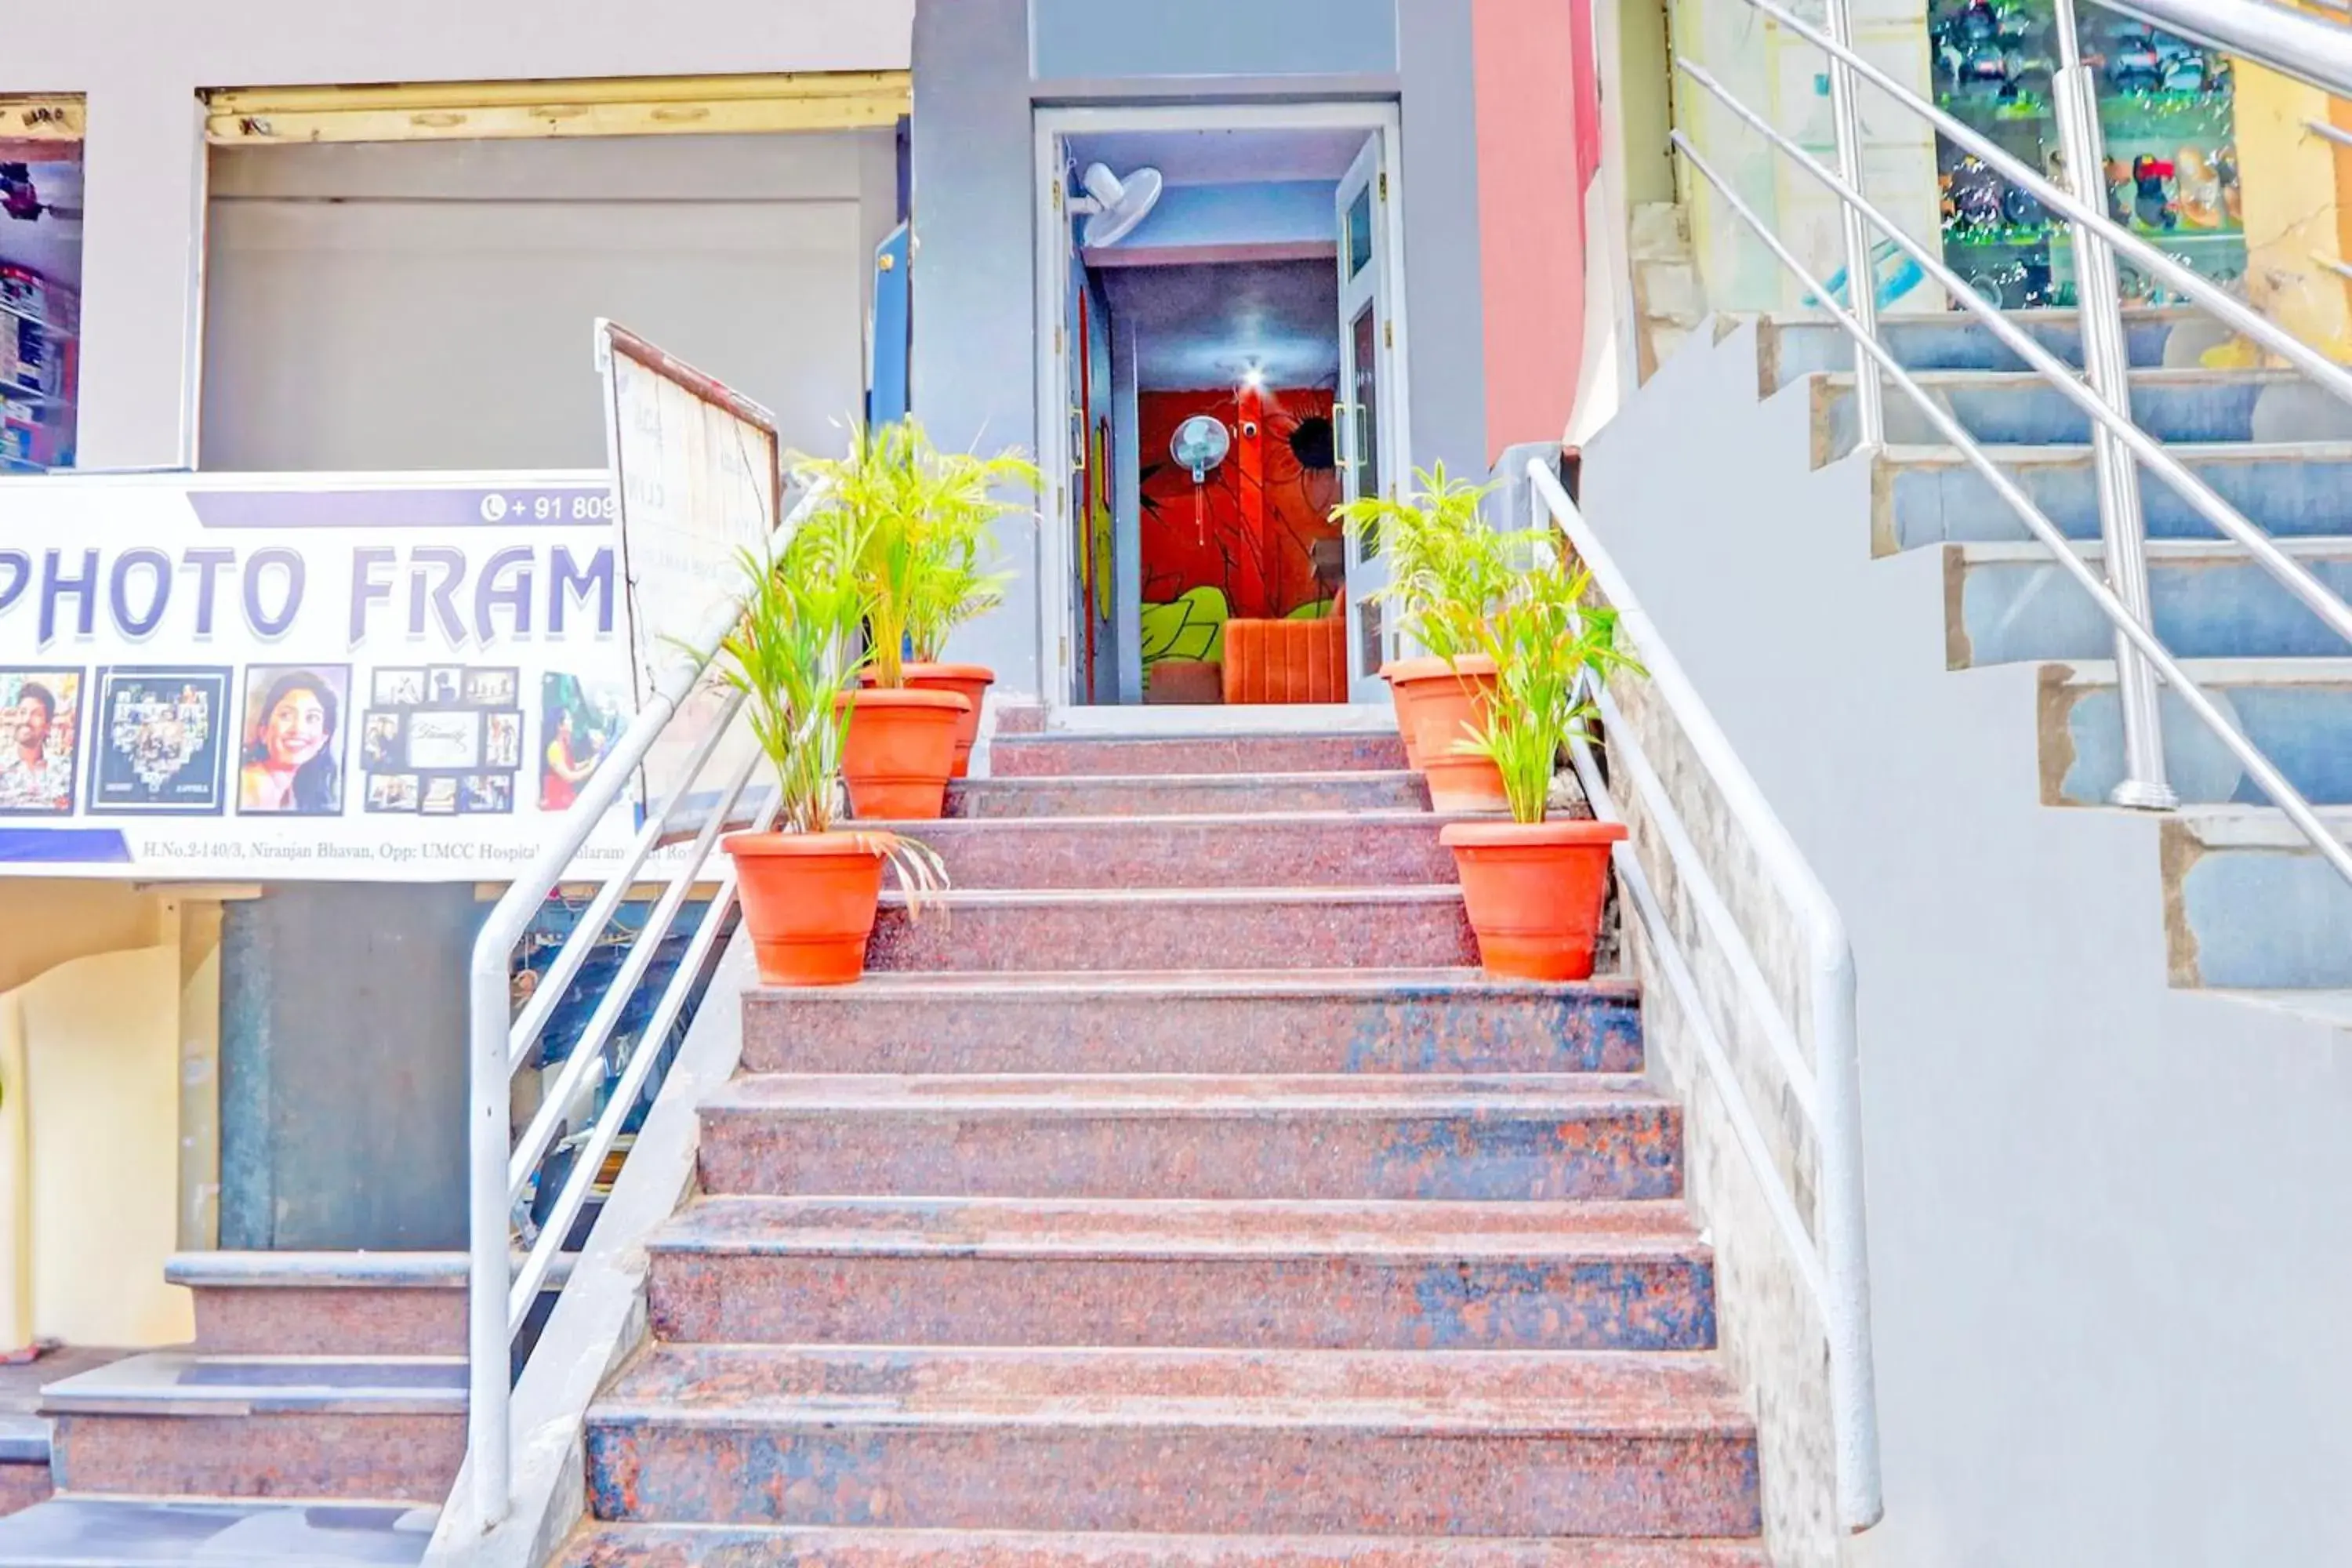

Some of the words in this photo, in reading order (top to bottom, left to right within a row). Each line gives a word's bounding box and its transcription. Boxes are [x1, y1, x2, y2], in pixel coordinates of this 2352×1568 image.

[534, 496, 561, 519] 91
[572, 496, 615, 519] 809
[347, 545, 615, 652] FRAM
[252, 841, 311, 861] Niranjan
[317, 842, 374, 860] Bhavan,
[379, 843, 417, 862] Opp:
[422, 843, 474, 859] UMCC
